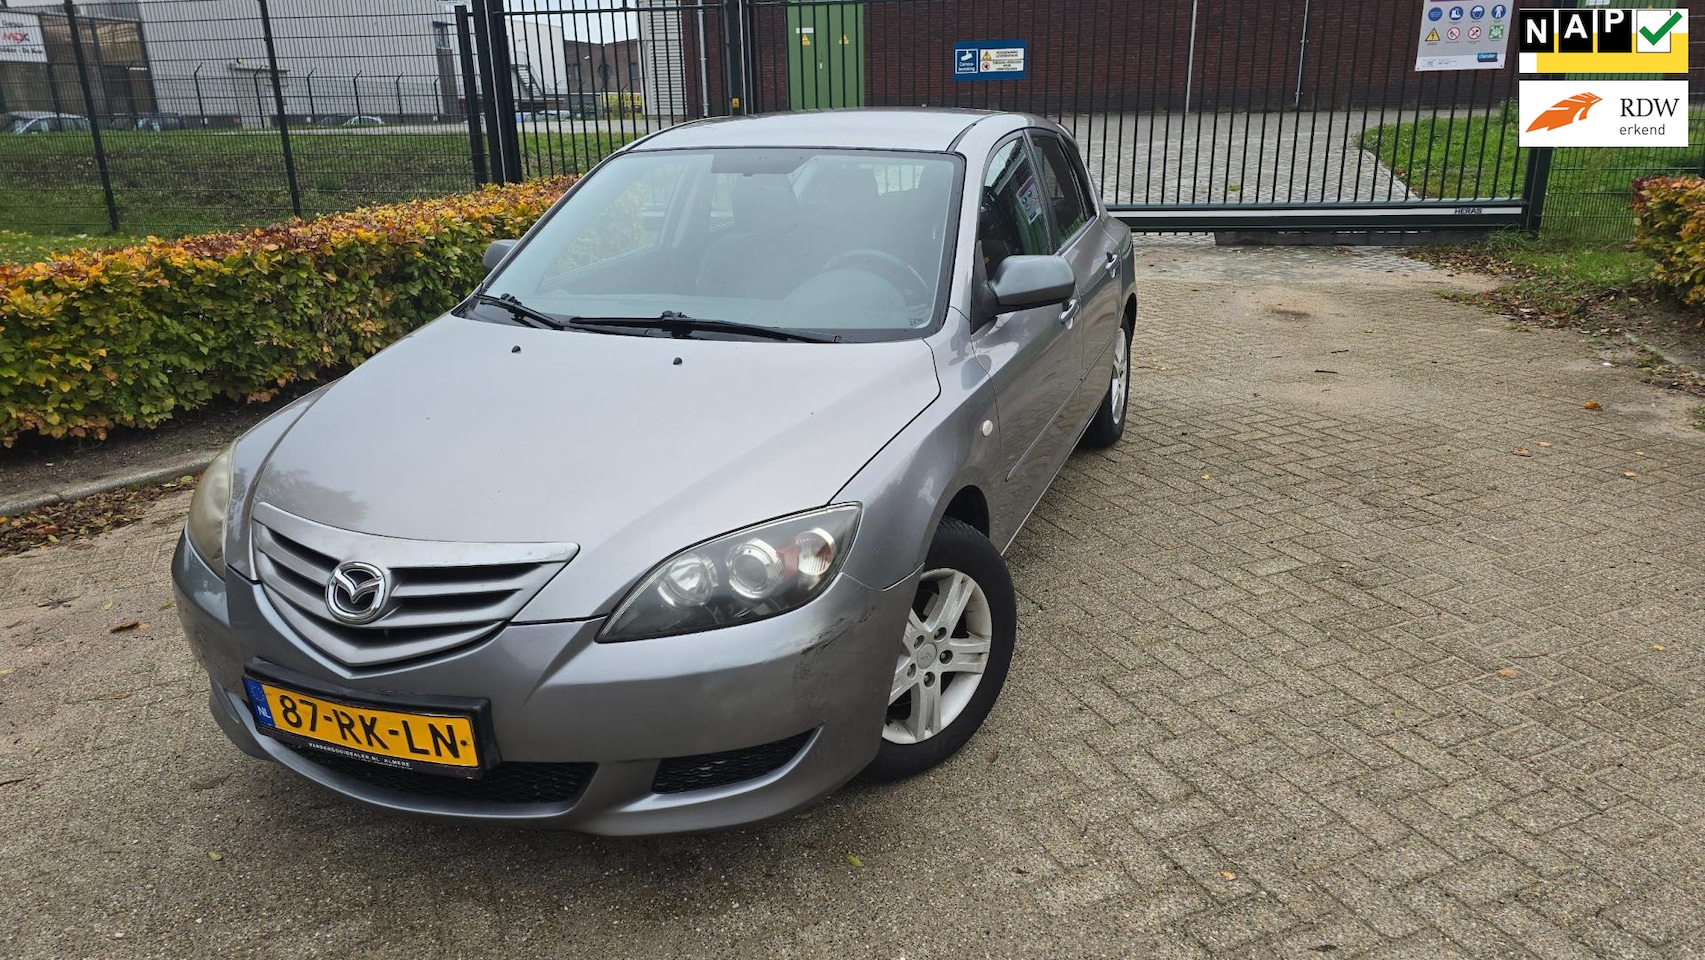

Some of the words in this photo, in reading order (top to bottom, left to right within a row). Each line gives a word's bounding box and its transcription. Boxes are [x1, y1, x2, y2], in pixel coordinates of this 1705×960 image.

[256, 706, 271, 720] NL
[278, 694, 461, 759] 87-RK-LN
[384, 758, 411, 768] ALMERE
